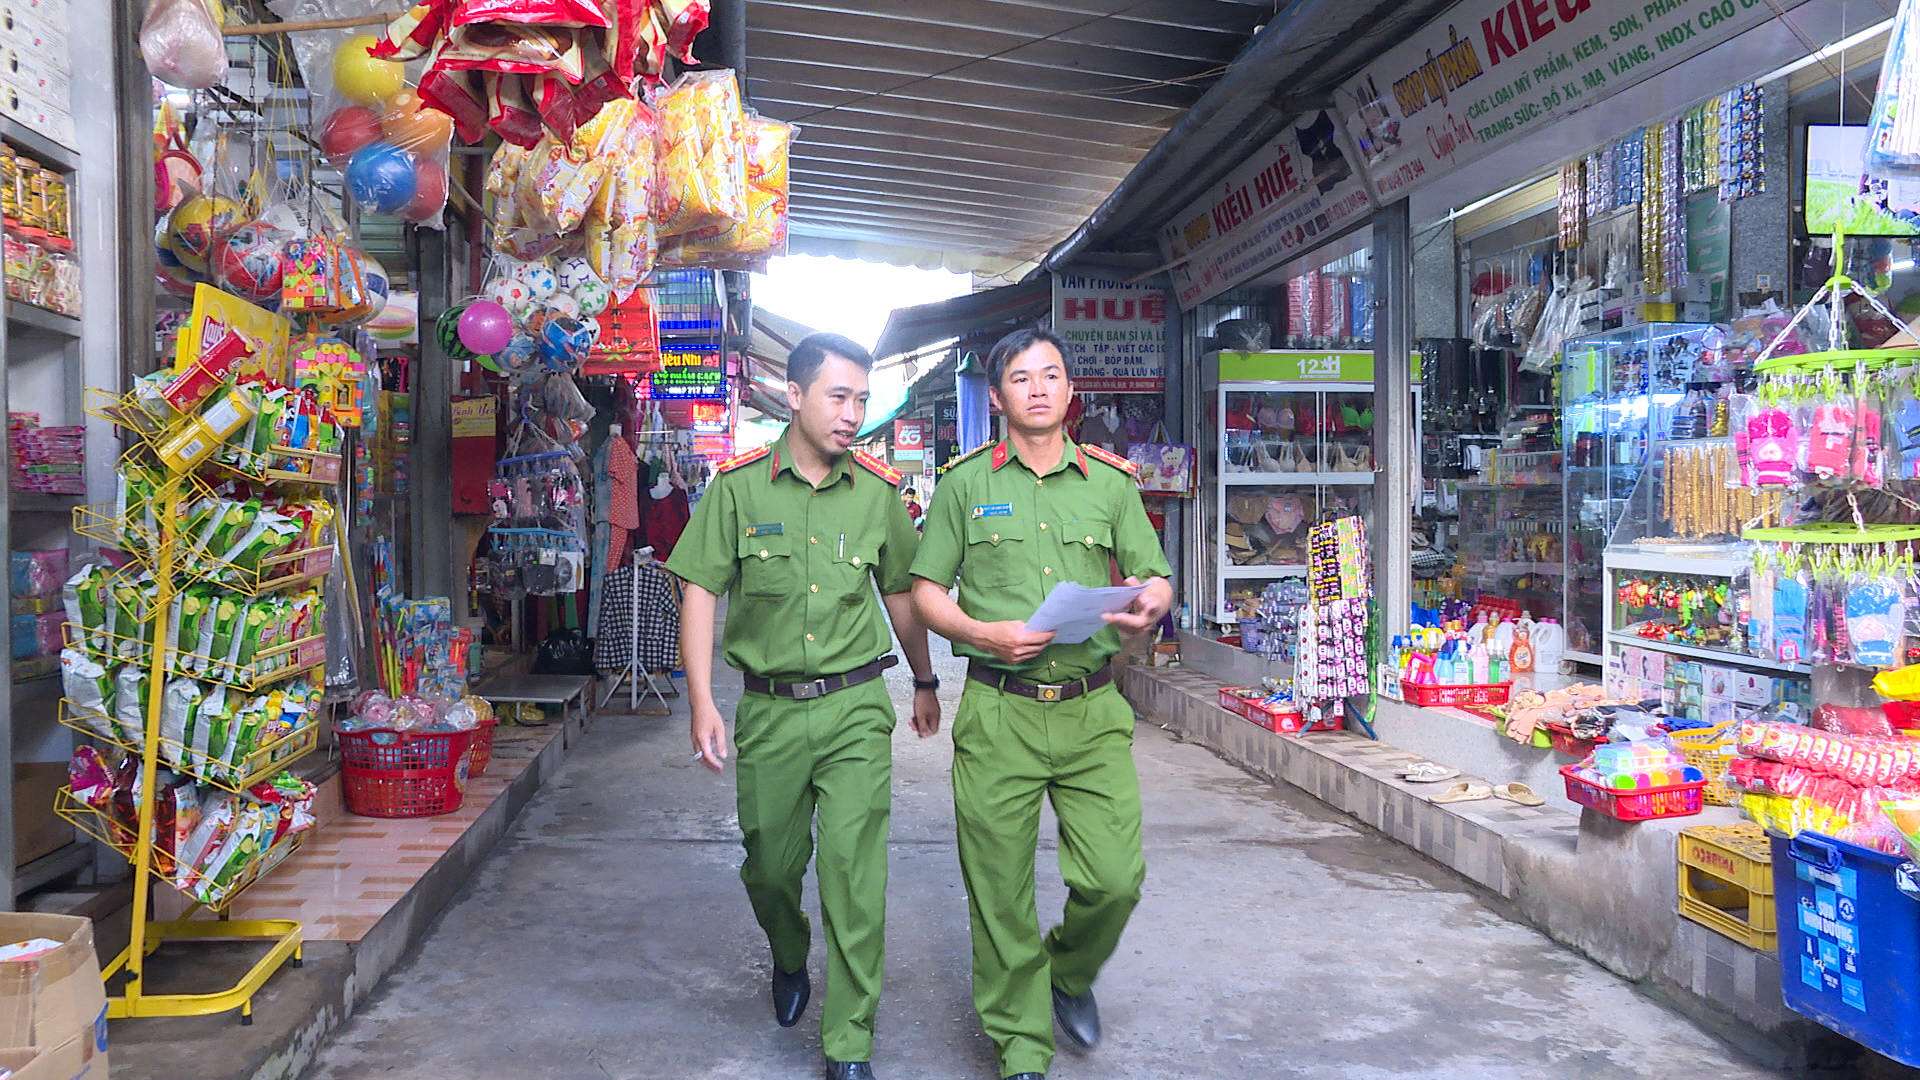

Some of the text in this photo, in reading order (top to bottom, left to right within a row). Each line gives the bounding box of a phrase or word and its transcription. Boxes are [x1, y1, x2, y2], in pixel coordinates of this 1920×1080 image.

[1490, 82, 1514, 108] LOẠI
[1572, 34, 1608, 62] KEM,
[1609, 14, 1643, 43] SON,
[1608, 44, 1655, 76] VÀNG,
[1655, 19, 1697, 52] INOX
[1698, 0, 1736, 30] CAO
[1212, 182, 1254, 236] KIỀU
[899, 430, 921, 446] 5G
